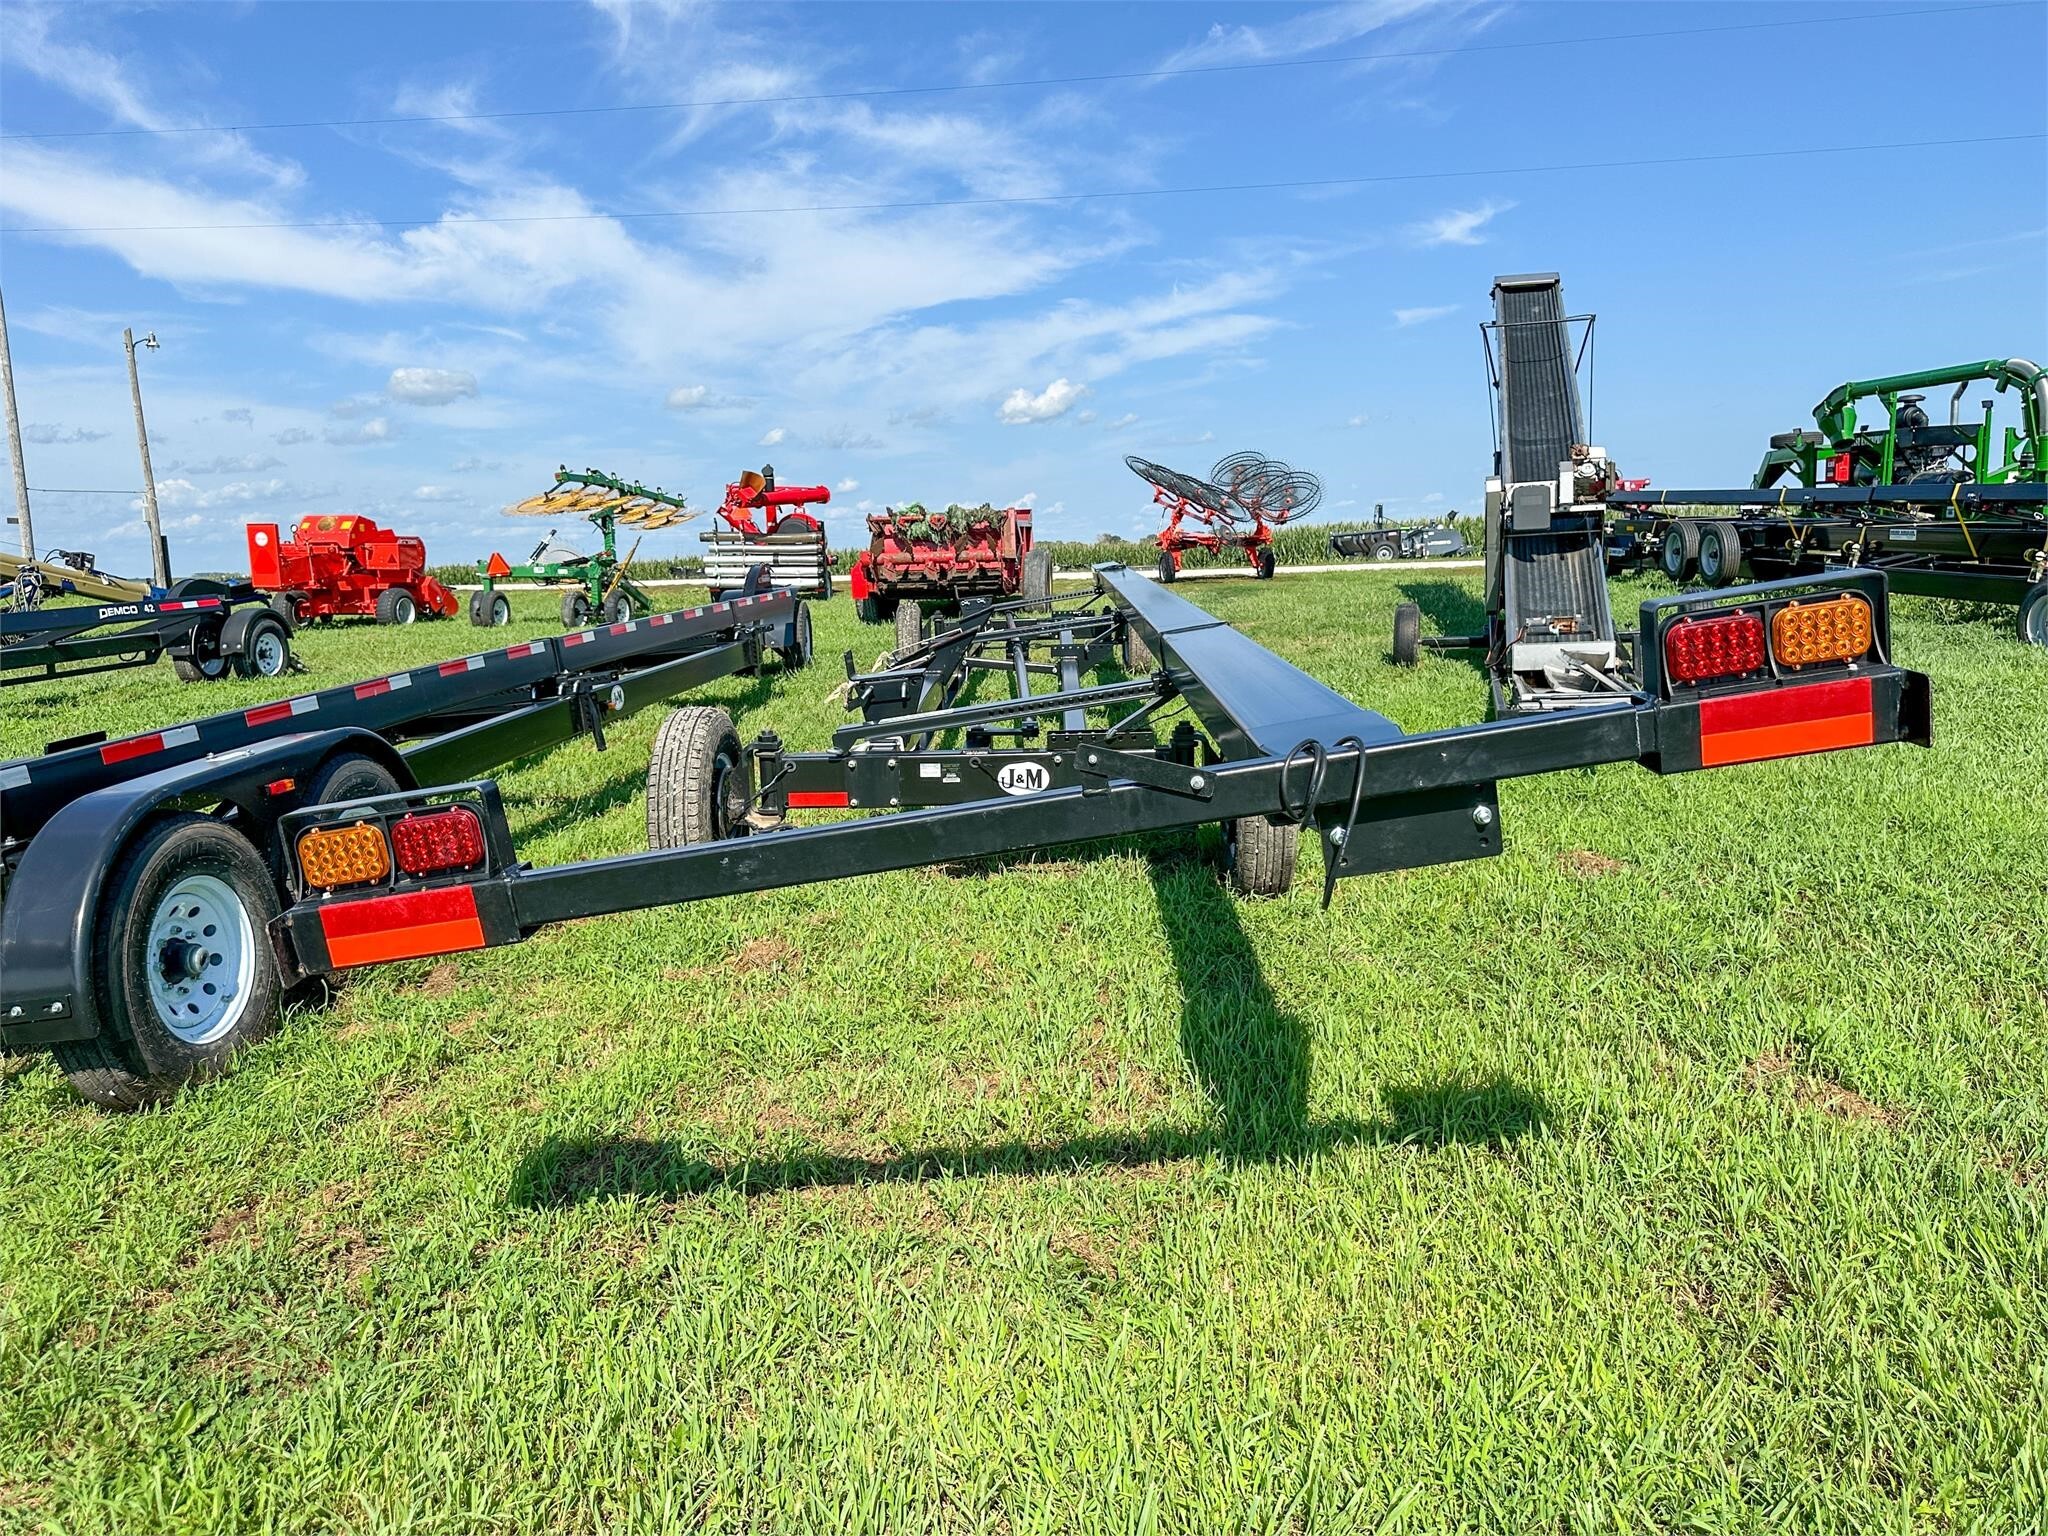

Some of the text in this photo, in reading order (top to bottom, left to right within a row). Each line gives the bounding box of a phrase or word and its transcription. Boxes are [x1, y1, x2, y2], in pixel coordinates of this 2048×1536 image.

[99, 604, 156, 620] DEMCO 42
[1001, 768, 1043, 789] J&M
